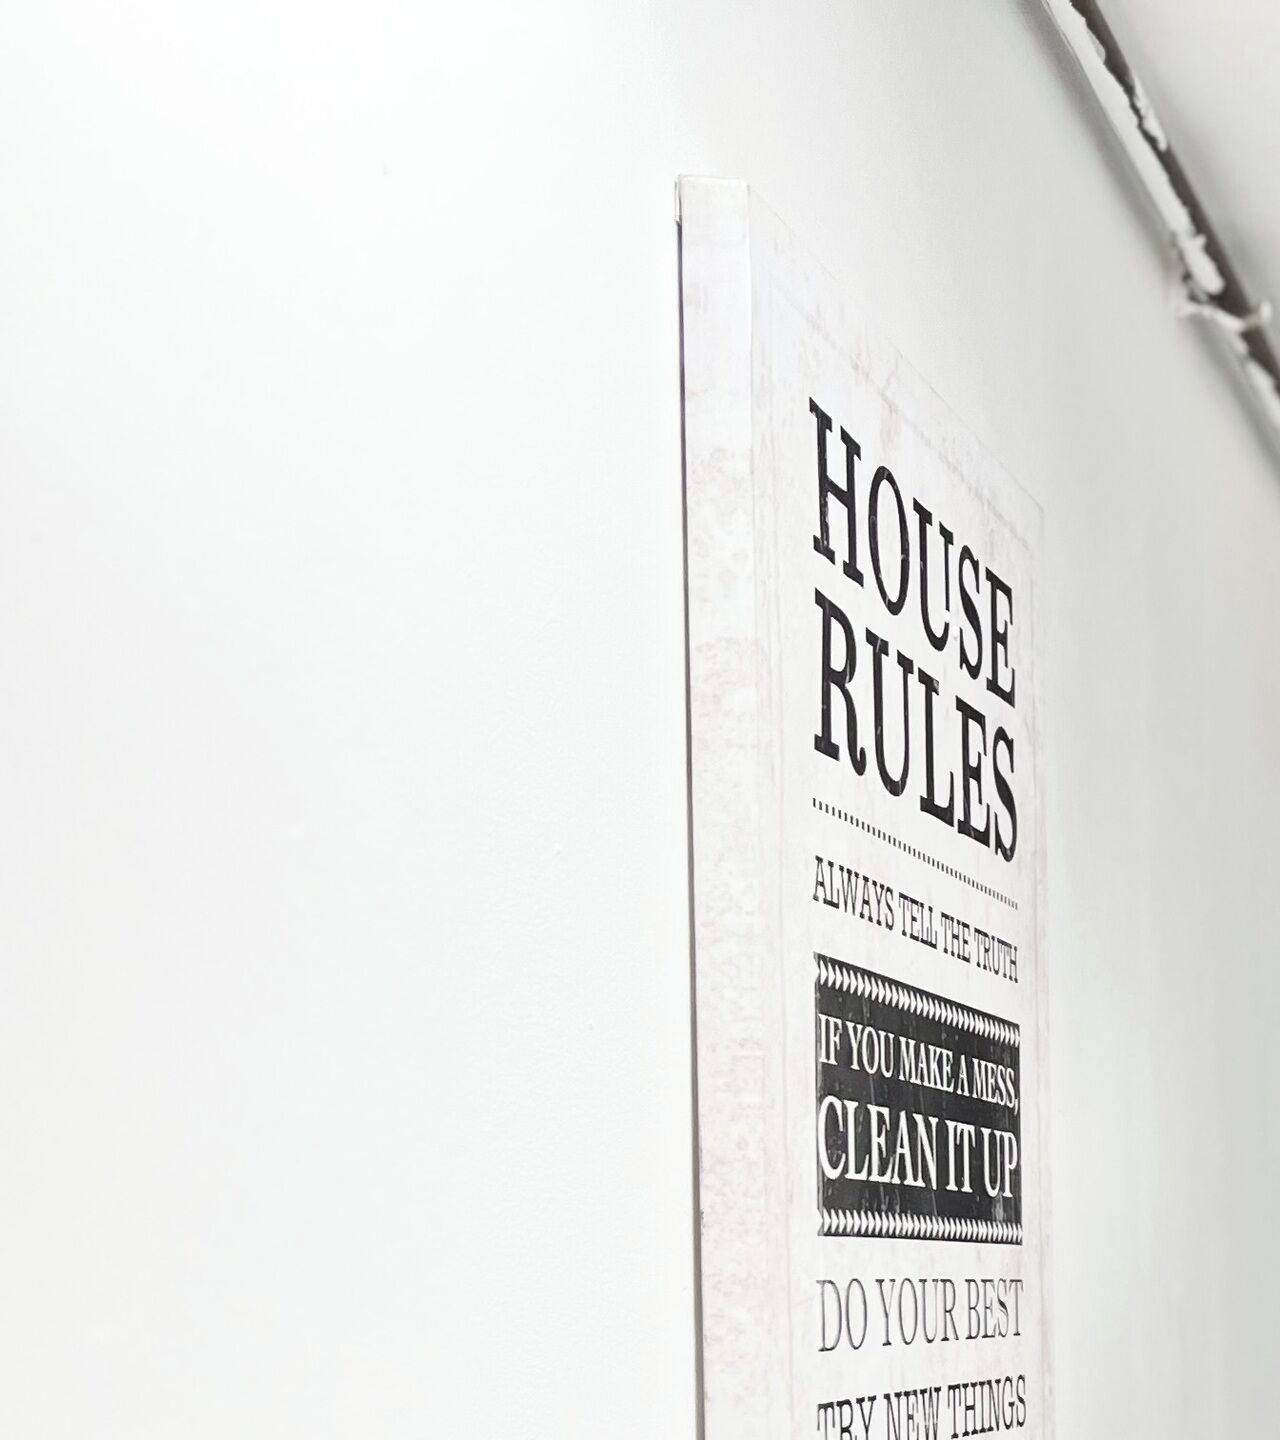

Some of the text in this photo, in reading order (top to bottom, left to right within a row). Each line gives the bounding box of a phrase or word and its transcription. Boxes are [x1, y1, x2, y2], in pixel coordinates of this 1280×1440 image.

[809, 396, 1016, 708] HOUSE
[814, 588, 1017, 863] RULES
[813, 855, 1019, 984] ALWAYS TELL THE TRUTH
[818, 1013, 1019, 1117] IF YOU MAKE A MESS,
[817, 1094, 1019, 1198] CLEAN IT UP
[816, 1277, 1025, 1352] DO YOUR BEST
[947, 1373, 1027, 1440] THINGS
